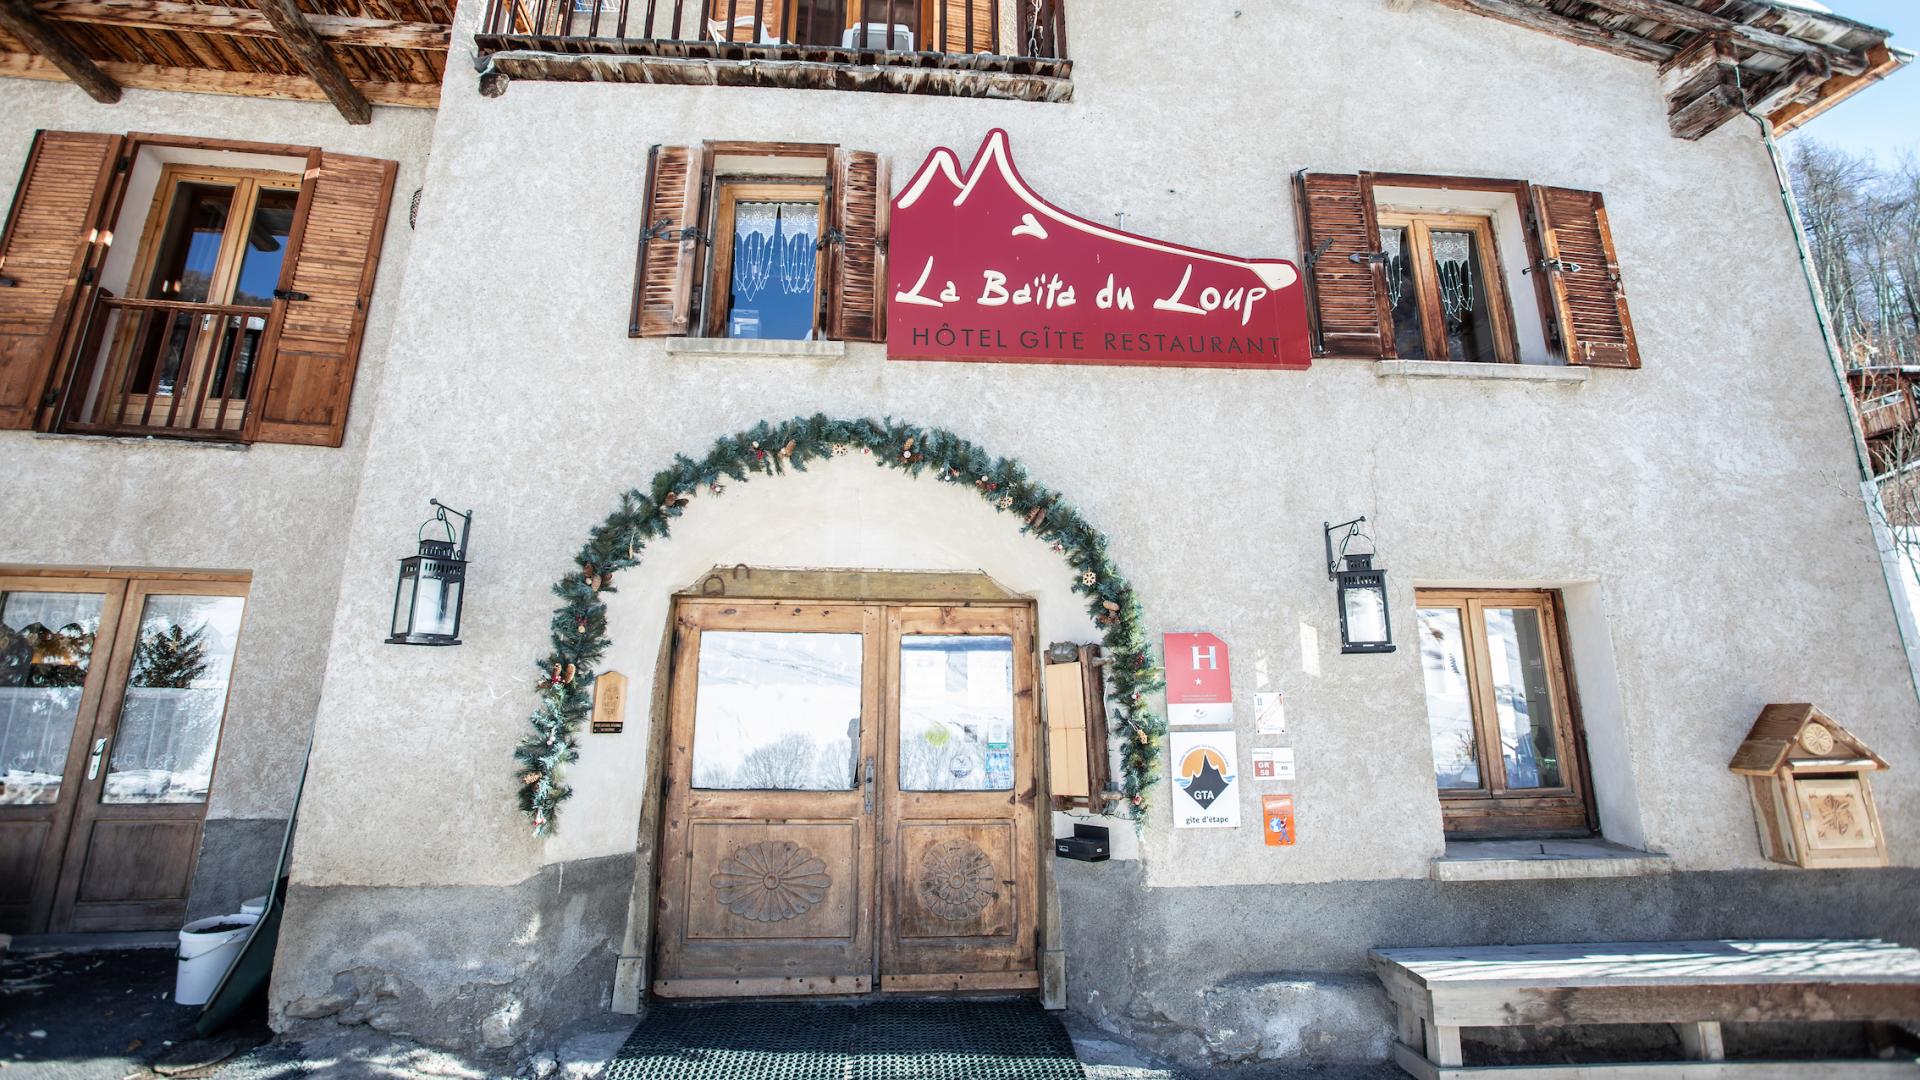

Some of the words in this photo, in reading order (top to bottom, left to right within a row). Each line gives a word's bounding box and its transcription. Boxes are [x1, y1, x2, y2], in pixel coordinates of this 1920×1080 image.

[895, 255, 960, 308] La
[977, 269, 1077, 310] Baïta
[1095, 273, 1135, 311] du
[1153, 263, 1268, 326] Loup
[912, 322, 1008, 349] HÔTEL
[1019, 325, 1085, 351] GÎTE
[1104, 331, 1281, 356] RESTAURANT
[1191, 646, 1217, 670] H
[1194, 790, 1215, 800] GTA
